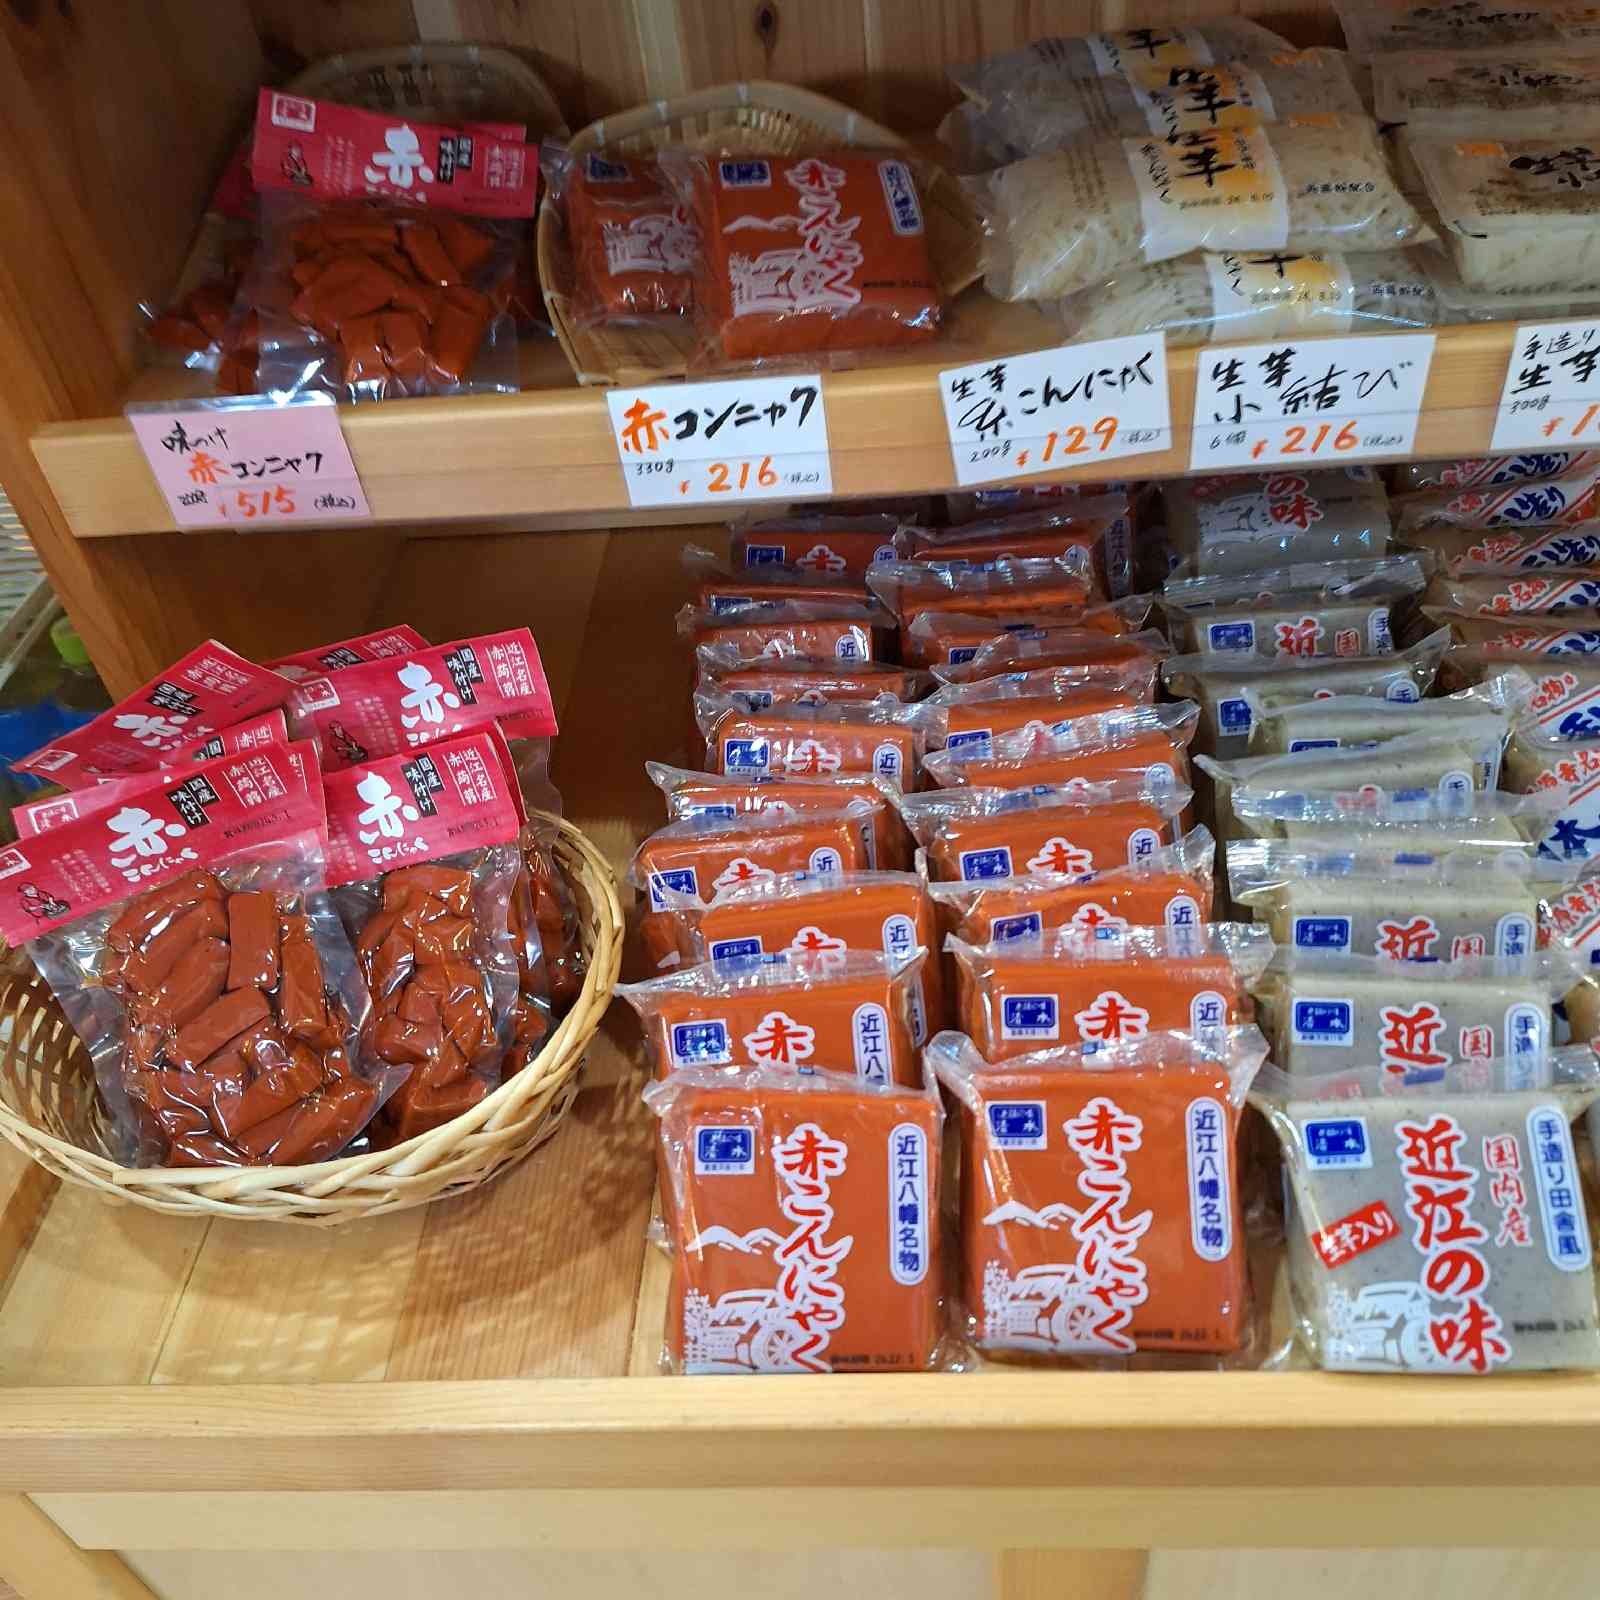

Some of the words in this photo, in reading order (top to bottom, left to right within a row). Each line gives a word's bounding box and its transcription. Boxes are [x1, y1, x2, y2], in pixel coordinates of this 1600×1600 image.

[364, 121, 434, 189] 赤
[788, 158, 861, 302] 赤こんにゃく
[1212, 348, 1297, 393] 生芋
[1523, 329, 1596, 361] 手造り
[951, 364, 1008, 402] 生芋
[1214, 361, 1414, 424] 小結び
[162, 420, 230, 454] 味つけ
[622, 385, 818, 454] 赤コンニャク
[187, 451, 323, 485] 赤コンニャク
[635, 458, 675, 476] 330g
[446, 656, 473, 701] 味付け
[461, 646, 482, 679] 国産
[501, 641, 534, 696] 近江名産
[396, 660, 462, 729] 赤
[112, 713, 189, 748] 赤
[187, 775, 216, 805] 国産
[403, 766, 433, 812] 味付け
[418, 756, 442, 789] 国産
[463, 748, 495, 802] 近江名産
[169, 789, 203, 828] 味付け
[356, 770, 420, 845] 赤
[106, 806, 187, 868] 赤
[751, 1016, 808, 1064] 赤
[1082, 996, 1143, 1041] 赤
[896, 1134, 921, 1273] 近江八幡名物
[1194, 1109, 1224, 1249] 近江八幡名物
[1483, 1135, 1530, 1246] 国内産
[1536, 1118, 1583, 1258] 手造り田舎風
[780, 1128, 843, 1374] 赤こんにゃく
[1072, 1104, 1144, 1350] 赤こんにゃく
[1319, 1207, 1396, 1264] 生芋入り
[1399, 1117, 1507, 1372] 近江の味
